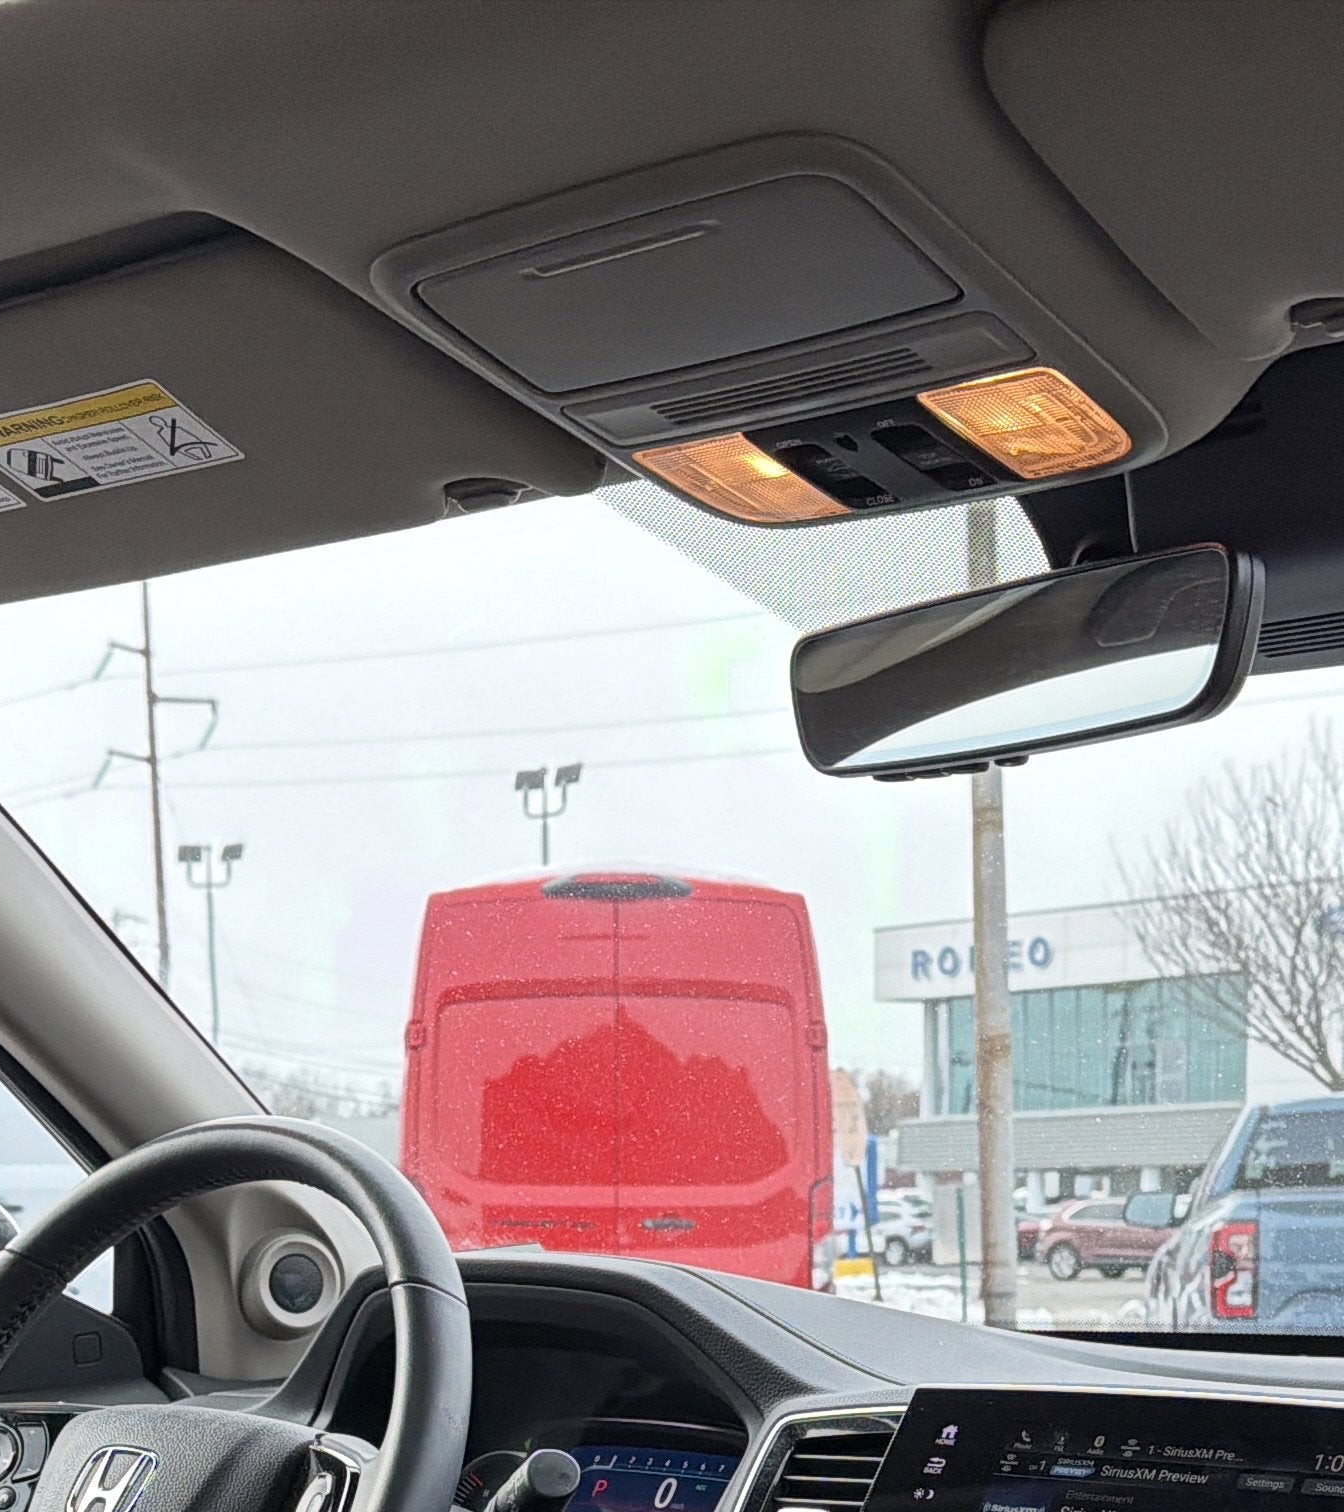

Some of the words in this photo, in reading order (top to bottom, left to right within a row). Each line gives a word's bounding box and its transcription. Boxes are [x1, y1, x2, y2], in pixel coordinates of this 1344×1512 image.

[911, 935, 1055, 982] ROEO
[1163, 1445, 1213, 1460] SiriusXM
[923, 1466, 943, 1475] BACK
[1100, 1465, 1156, 1481] SiriusXM
[1158, 1469, 1209, 1485] Preview
[592, 1479, 608, 1498] P
[1245, 1477, 1285, 1490] Settings
[654, 1477, 678, 1509] 0
[1064, 1489, 1134, 1505] Entertainment
